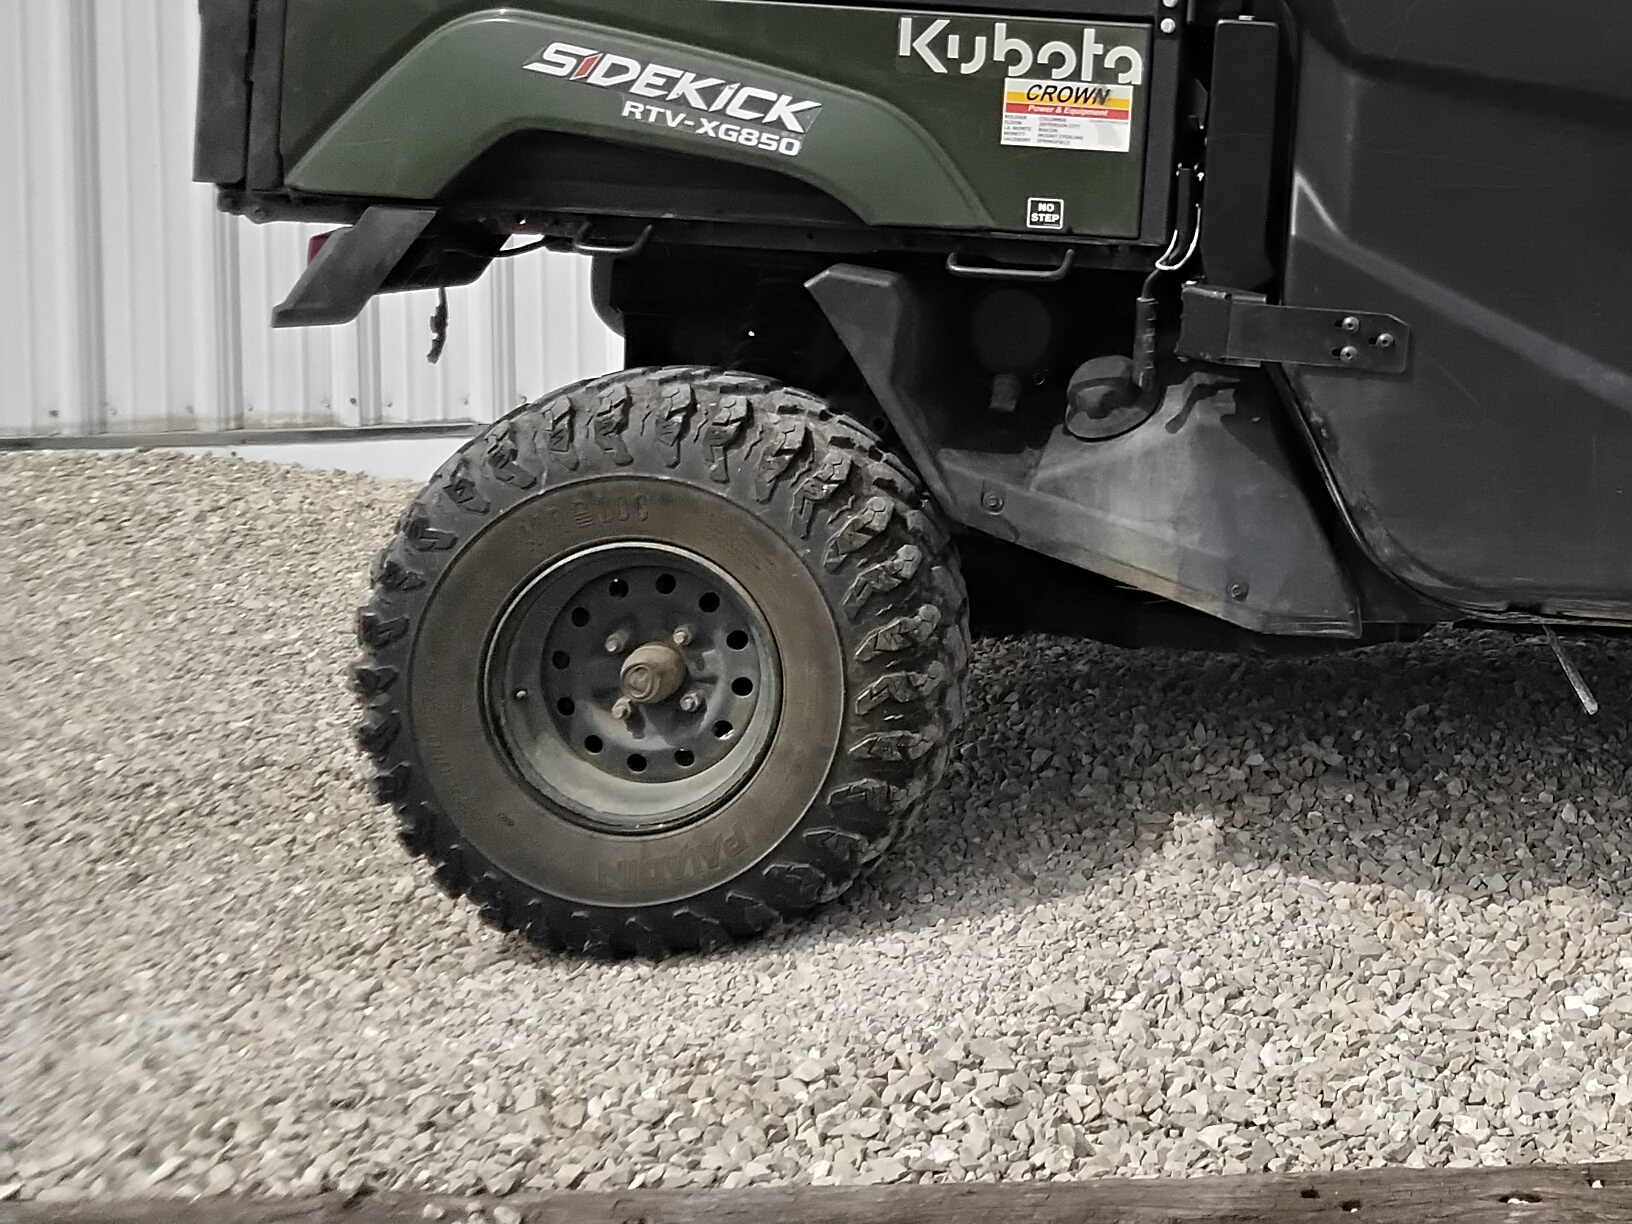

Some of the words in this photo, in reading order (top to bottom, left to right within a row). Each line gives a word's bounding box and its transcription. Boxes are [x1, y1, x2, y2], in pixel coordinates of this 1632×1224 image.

[899, 17, 1143, 85] Kubota
[522, 42, 822, 133] SIDEKICK
[1026, 84, 1111, 106] CROWN
[1028, 104, 1054, 114] Power
[1063, 107, 1109, 117] Equipment
[622, 101, 801, 156] RTV-XG850
[1031, 212, 1060, 223] STEP
[1038, 203, 1055, 212] NO
